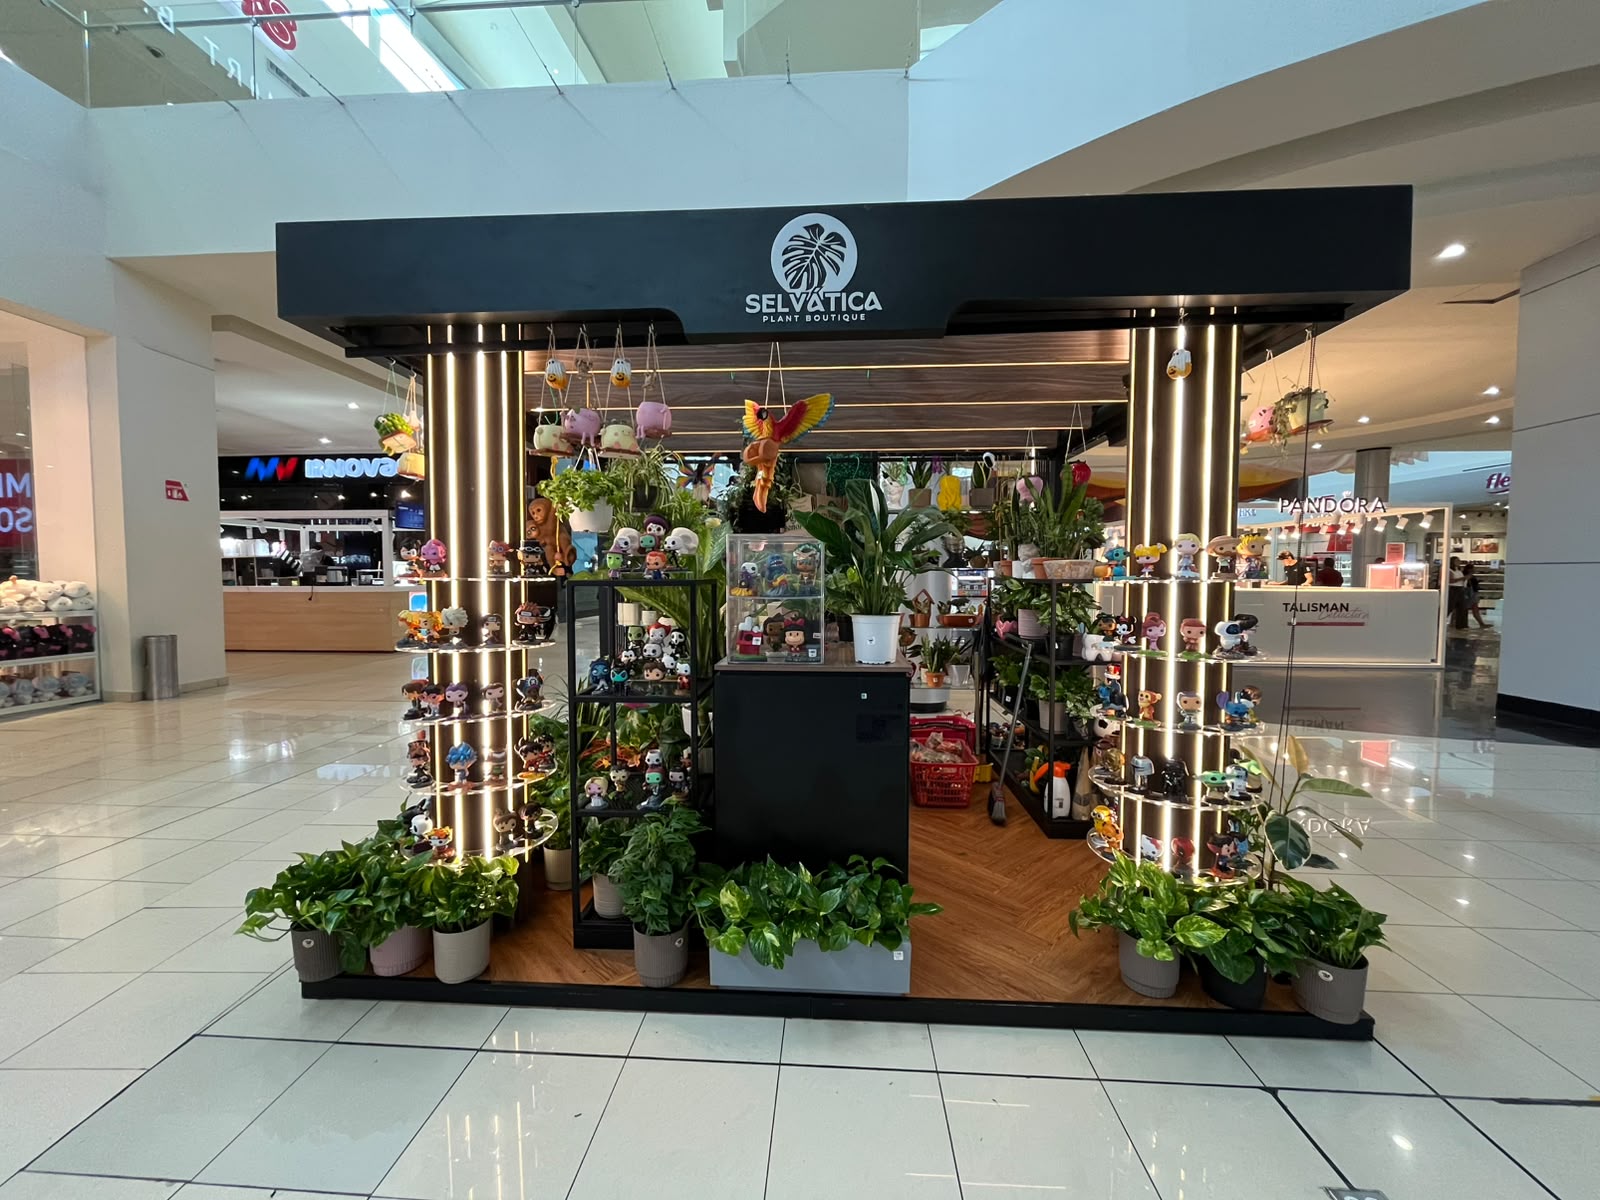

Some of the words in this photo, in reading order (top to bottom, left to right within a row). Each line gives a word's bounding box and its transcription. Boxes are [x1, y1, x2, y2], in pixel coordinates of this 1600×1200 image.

[762, 315, 800, 323] PLANT
[805, 313, 867, 323] BOUTIQUE
[1279, 495, 1387, 514] PANDORA
[1283, 602, 1350, 612] TALISMAN
